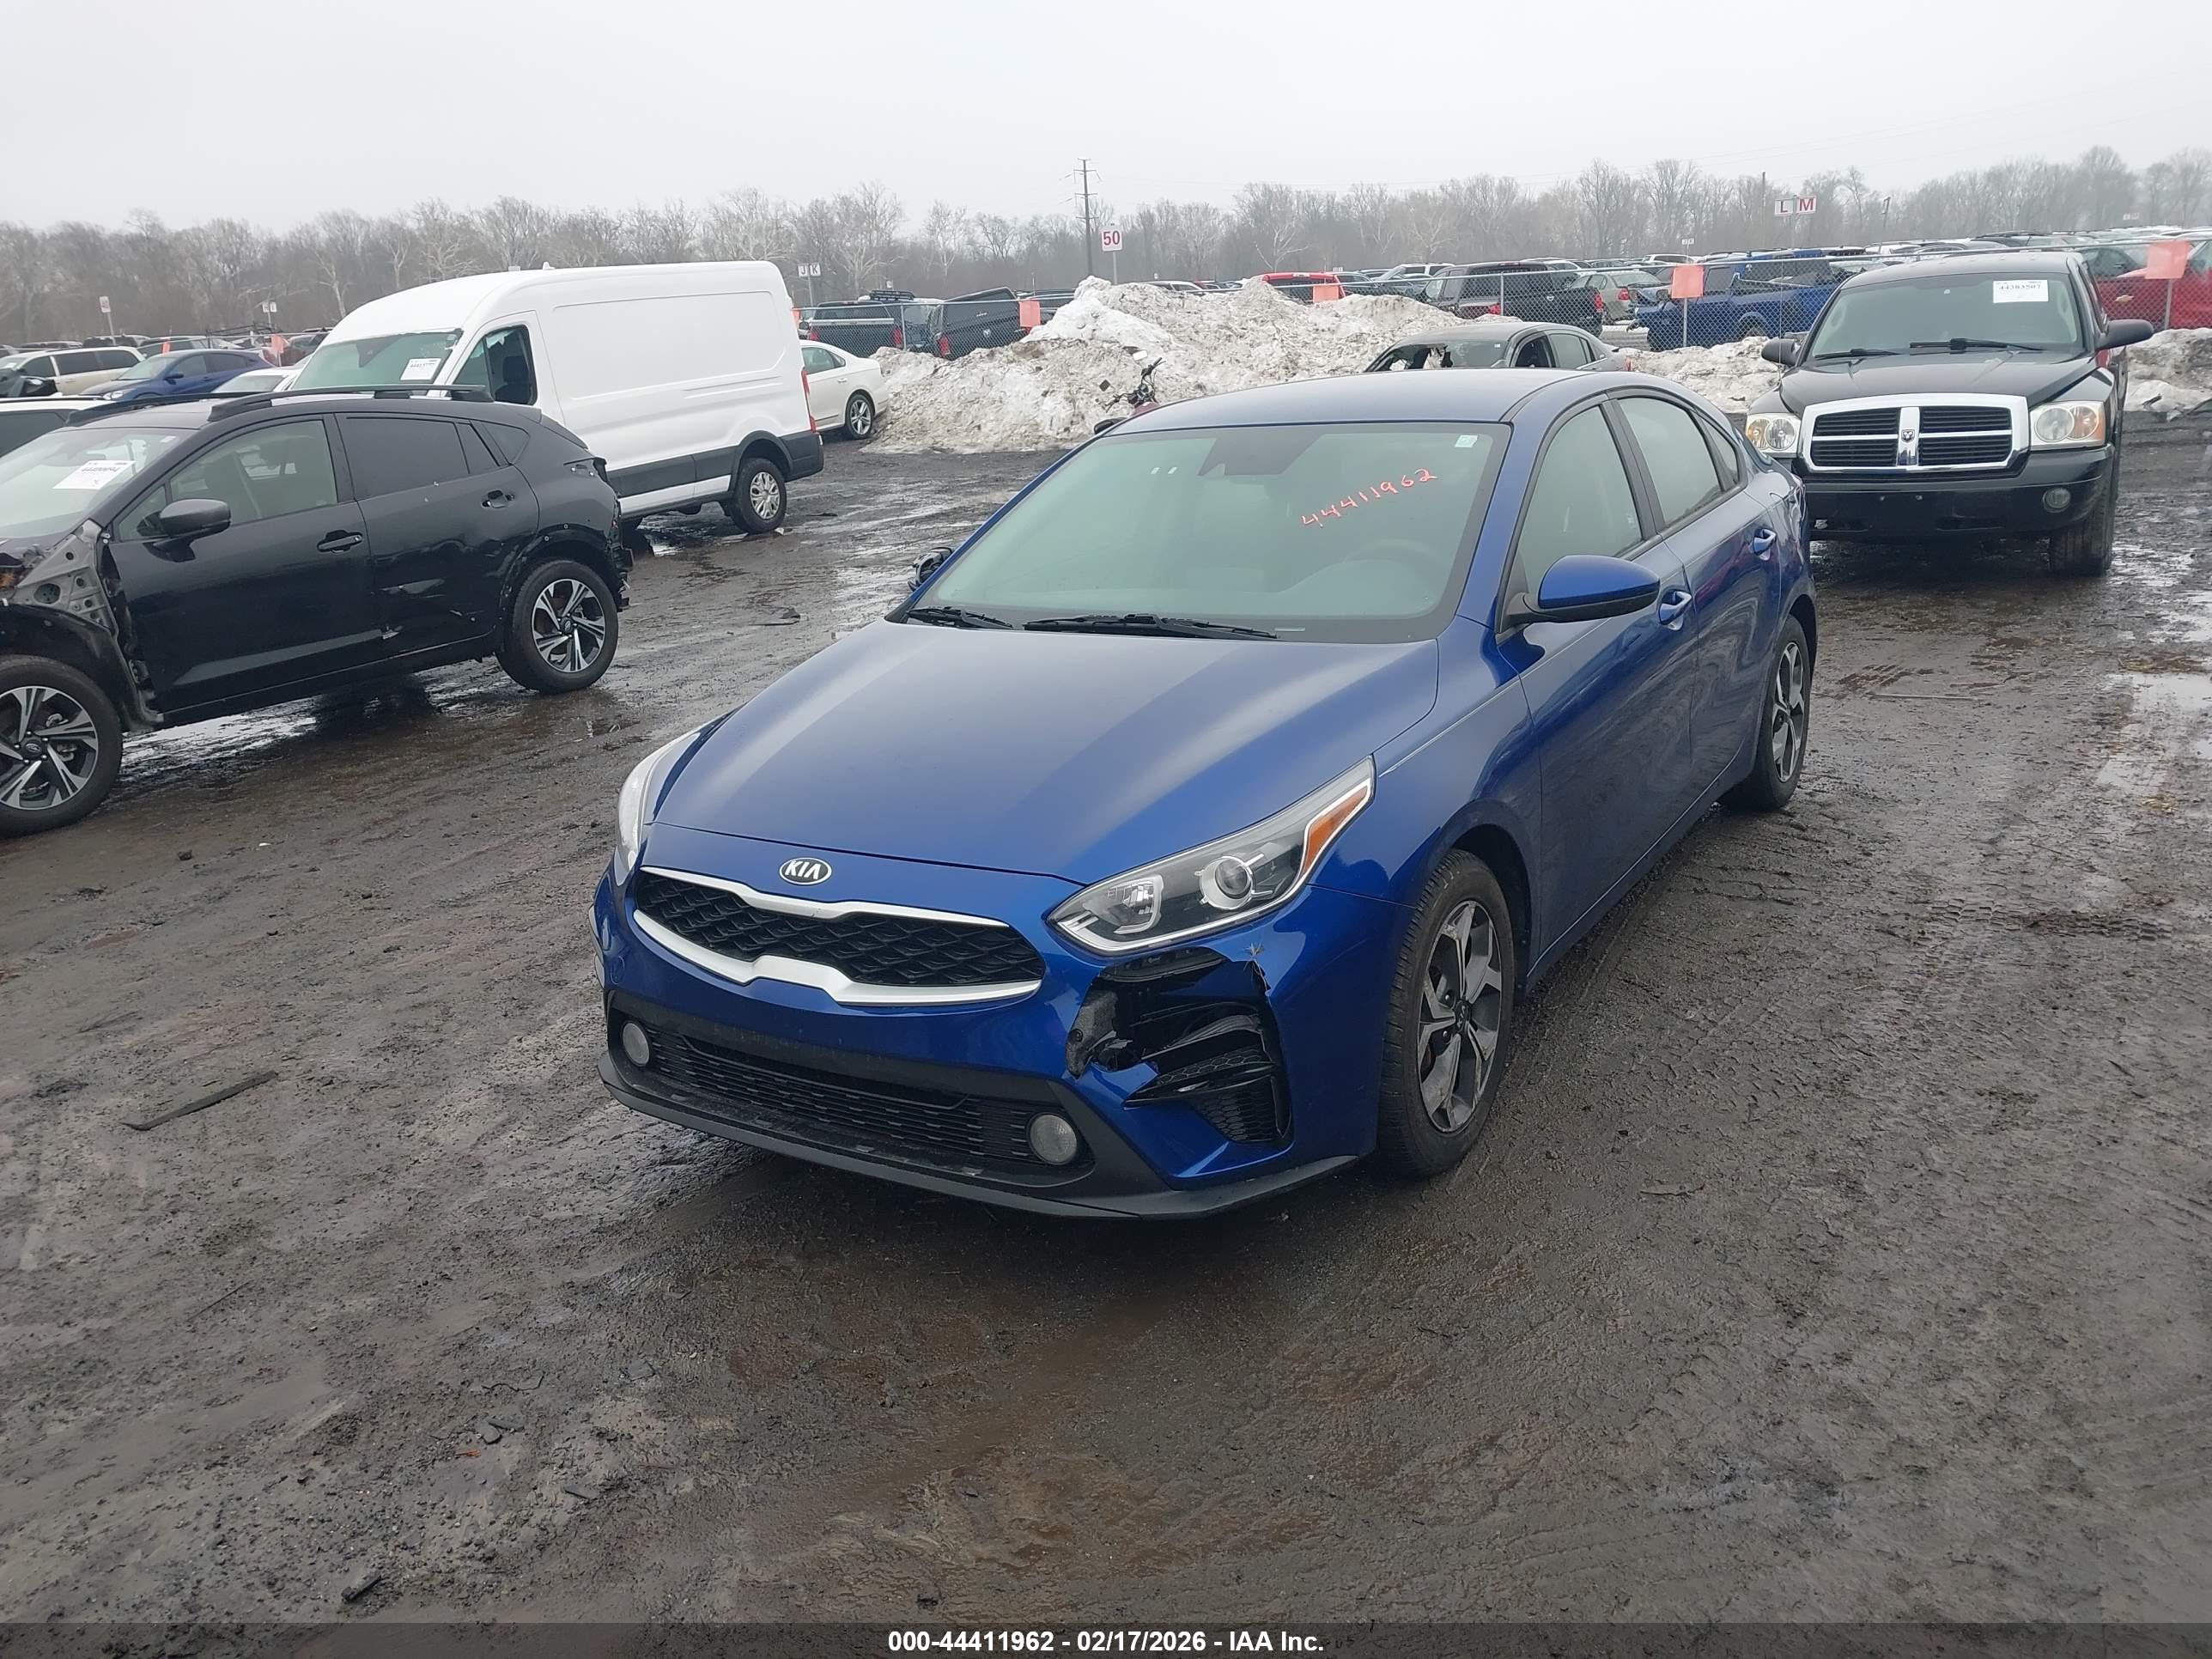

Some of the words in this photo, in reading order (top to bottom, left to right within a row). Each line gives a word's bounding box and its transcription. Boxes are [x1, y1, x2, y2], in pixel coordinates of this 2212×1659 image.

[1780, 200, 1788, 213] L
[1799, 198, 1814, 211] M
[1103, 230, 1120, 246] 50
[811, 264, 818, 275] K
[1302, 468, 1437, 527] 44411962
[785, 860, 822, 880] KIA
